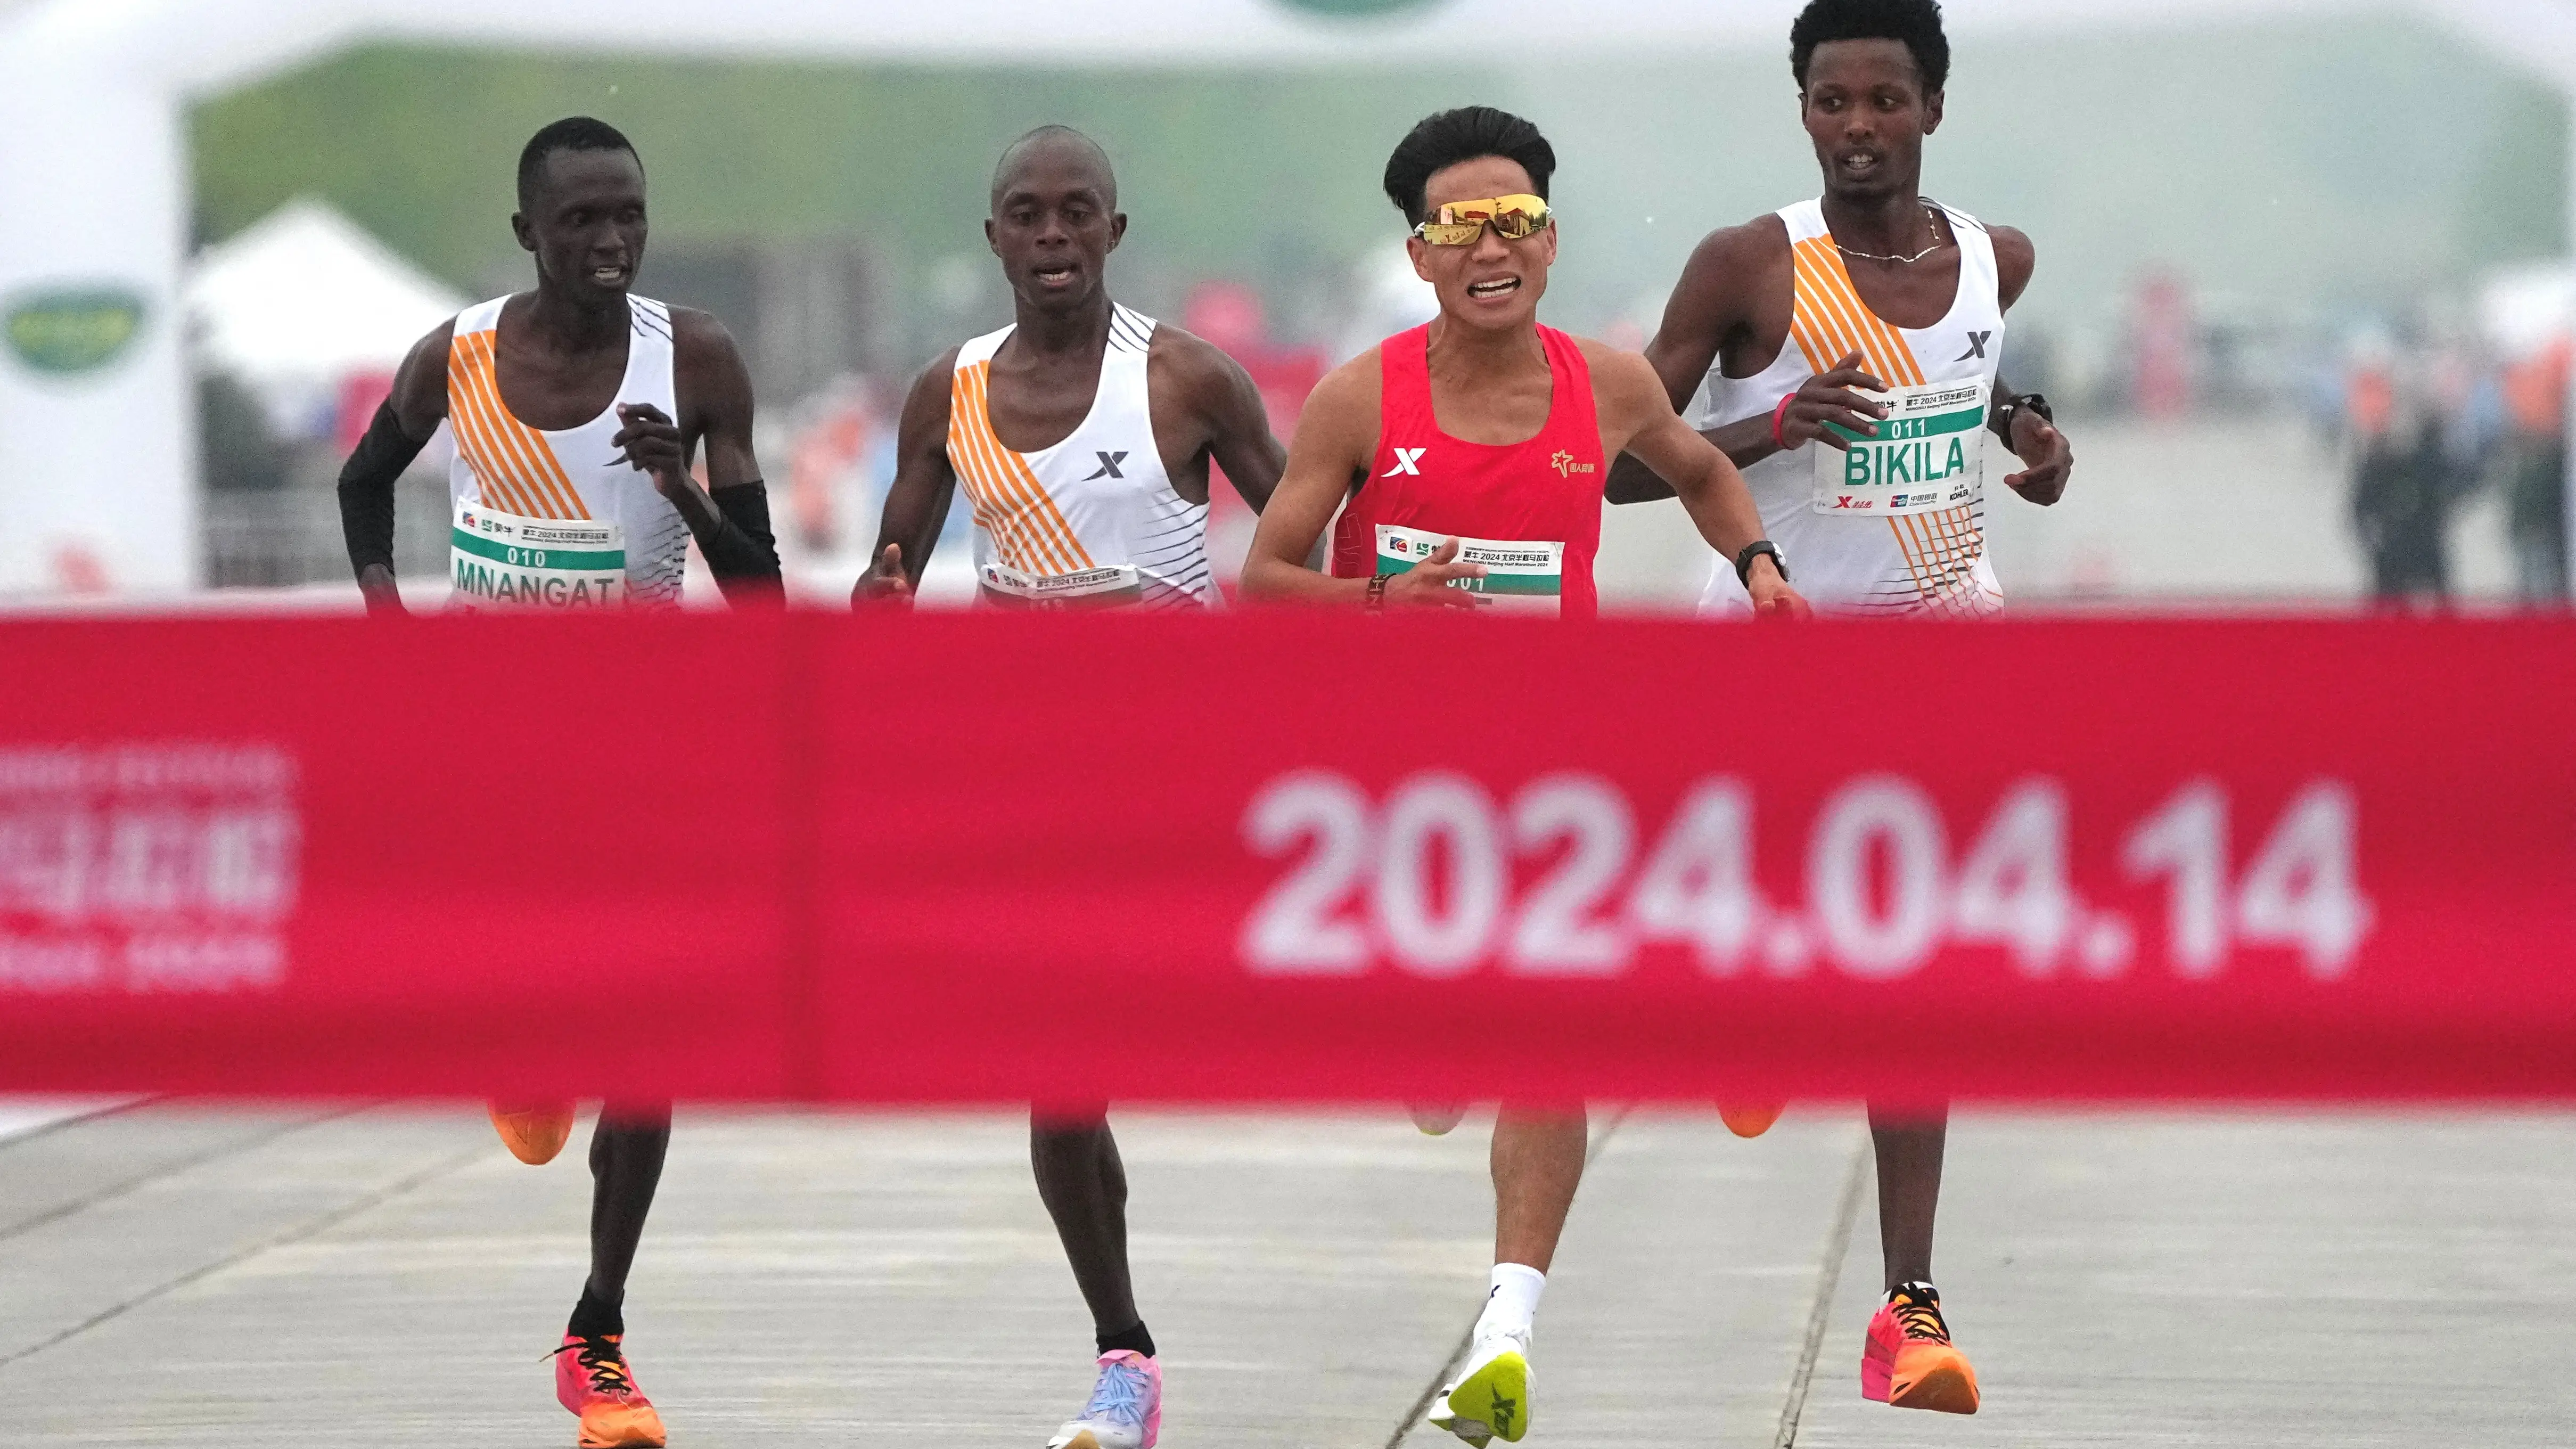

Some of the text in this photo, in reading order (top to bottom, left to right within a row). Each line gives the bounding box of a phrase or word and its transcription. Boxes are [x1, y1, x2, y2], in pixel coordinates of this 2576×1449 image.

[1892, 419, 1925, 439] 011
[1845, 437, 1964, 486] BIKILA
[1950, 489, 1968, 501] KOHLER
[507, 547, 546, 568] 010
[457, 558, 614, 608] MNANGAT
[1242, 772, 2368, 978] 2024.04.14
